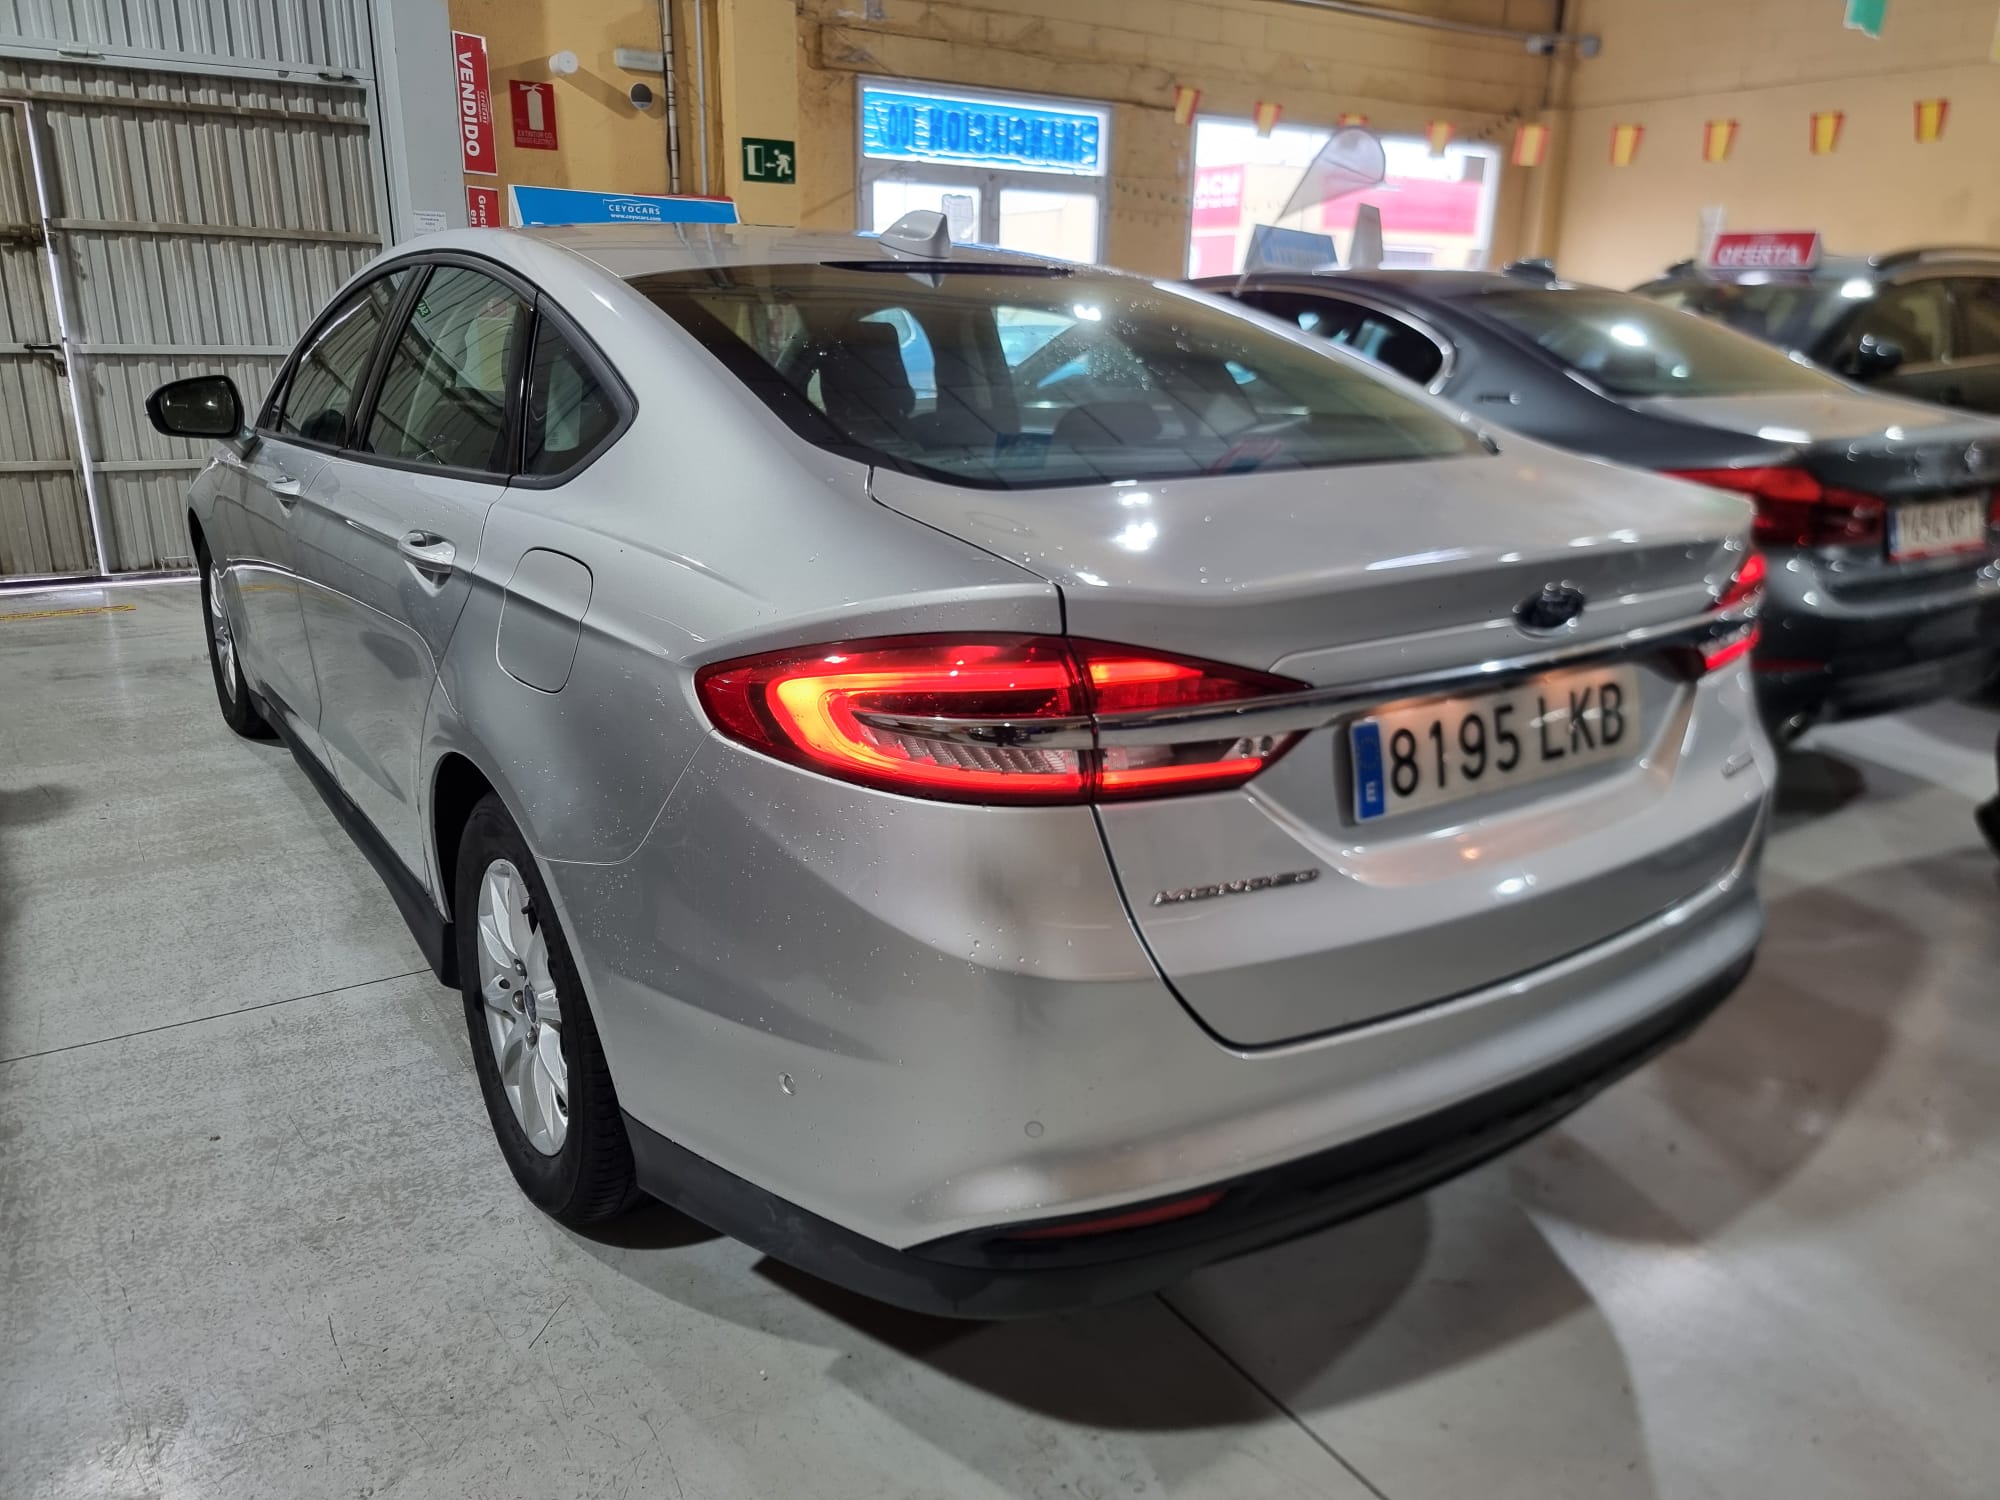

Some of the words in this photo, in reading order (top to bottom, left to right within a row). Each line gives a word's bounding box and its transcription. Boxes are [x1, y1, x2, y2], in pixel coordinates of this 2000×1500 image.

[458, 51, 480, 157] VENDIDO
[608, 204, 661, 215] CEYOCARS
[1718, 244, 1799, 266] OFERTA
[1389, 704, 1520, 798] 8195
[1537, 682, 1626, 762] LKB
[1365, 780, 1380, 803] E
